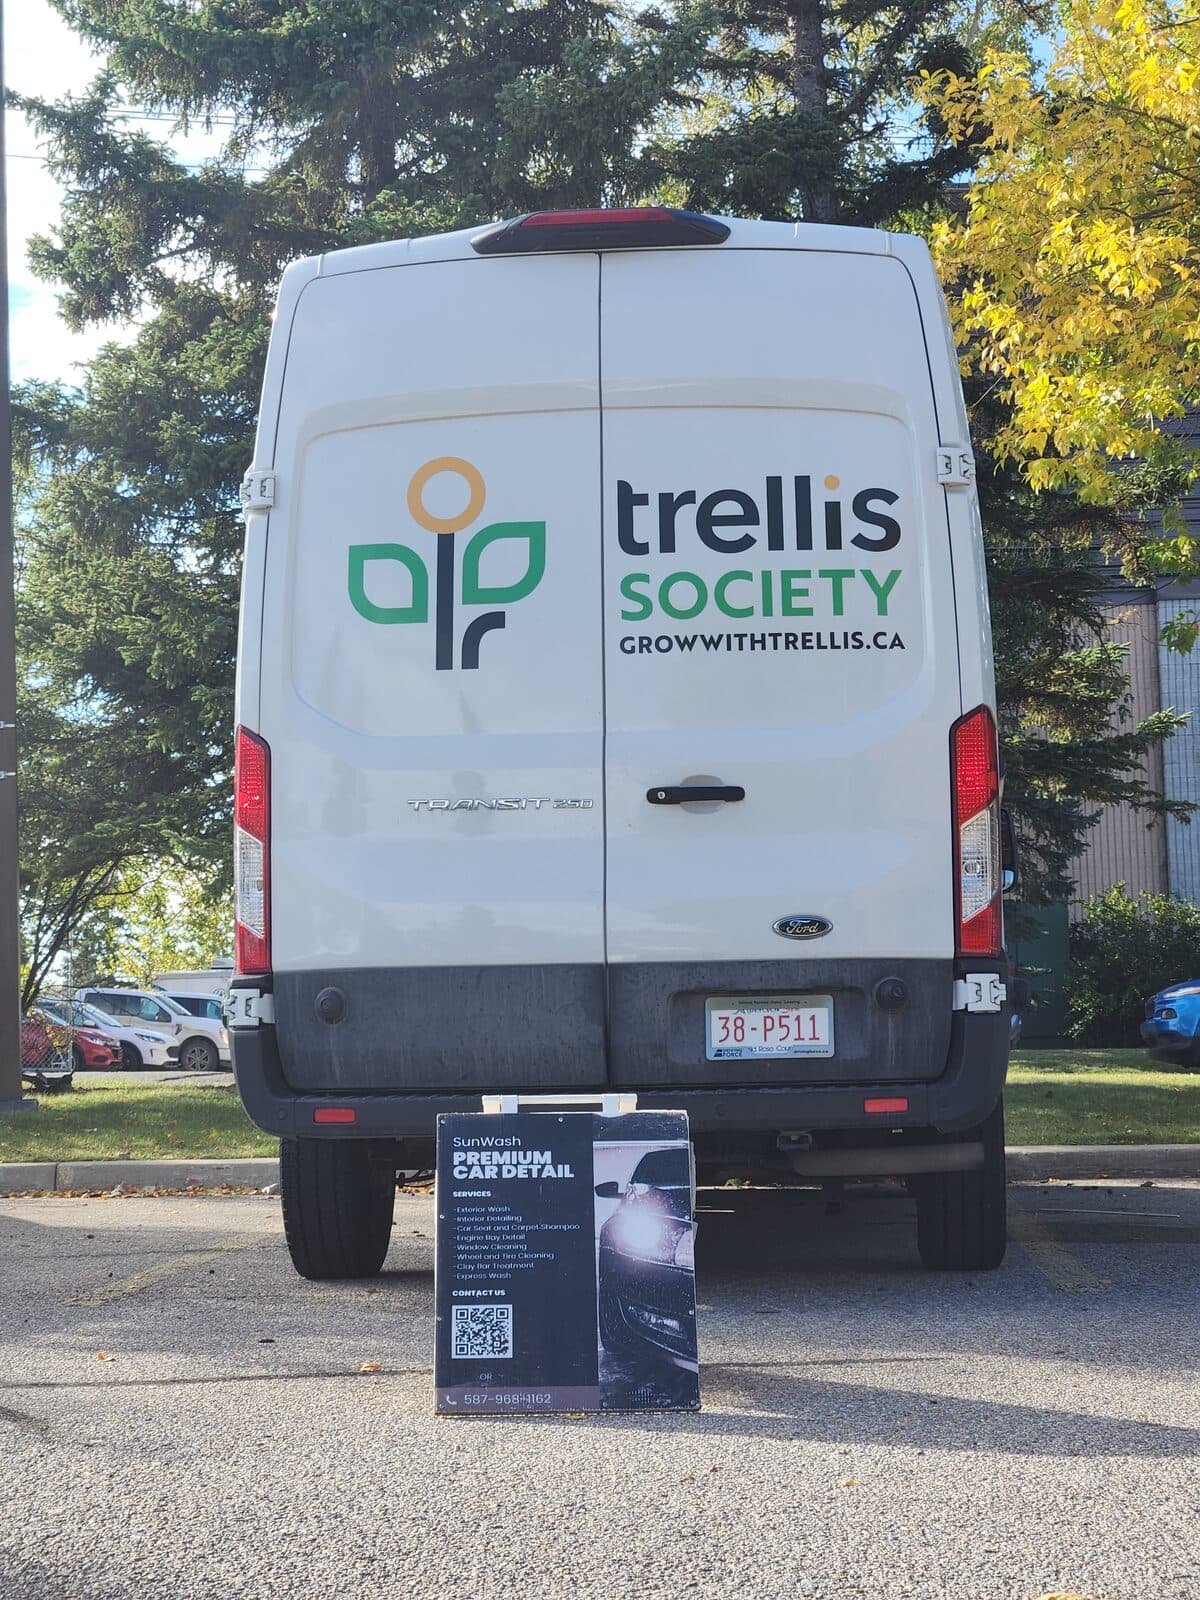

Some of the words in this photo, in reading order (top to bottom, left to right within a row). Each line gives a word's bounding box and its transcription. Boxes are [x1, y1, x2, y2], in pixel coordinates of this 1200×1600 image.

[617, 474, 902, 556] trellis
[620, 569, 903, 621] SOCIETY
[619, 631, 907, 655] GROWWITHTRELLIS.CA
[407, 798, 550, 811] TRANSIT
[553, 799, 594, 809] 250
[718, 1014, 820, 1043] 38-P511
[453, 1136, 521, 1147] SunWash
[453, 1150, 552, 1165] PREMIUM
[453, 1165, 498, 1179] CAR
[502, 1164, 575, 1178] DETAIL
[453, 1190, 492, 1198] SERVICES
[487, 1205, 511, 1213] Wash
[486, 1214, 522, 1222] Detailing
[485, 1234, 501, 1242] Bay
[502, 1233, 526, 1241] Detail
[490, 1243, 528, 1251] Cleaning
[518, 1251, 555, 1260] Cleaning
[492, 1261, 535, 1269] Treatment
[488, 1271, 512, 1279] Wash
[452, 1289, 494, 1297] CONTACT
[479, 1373, 493, 1381] OR
